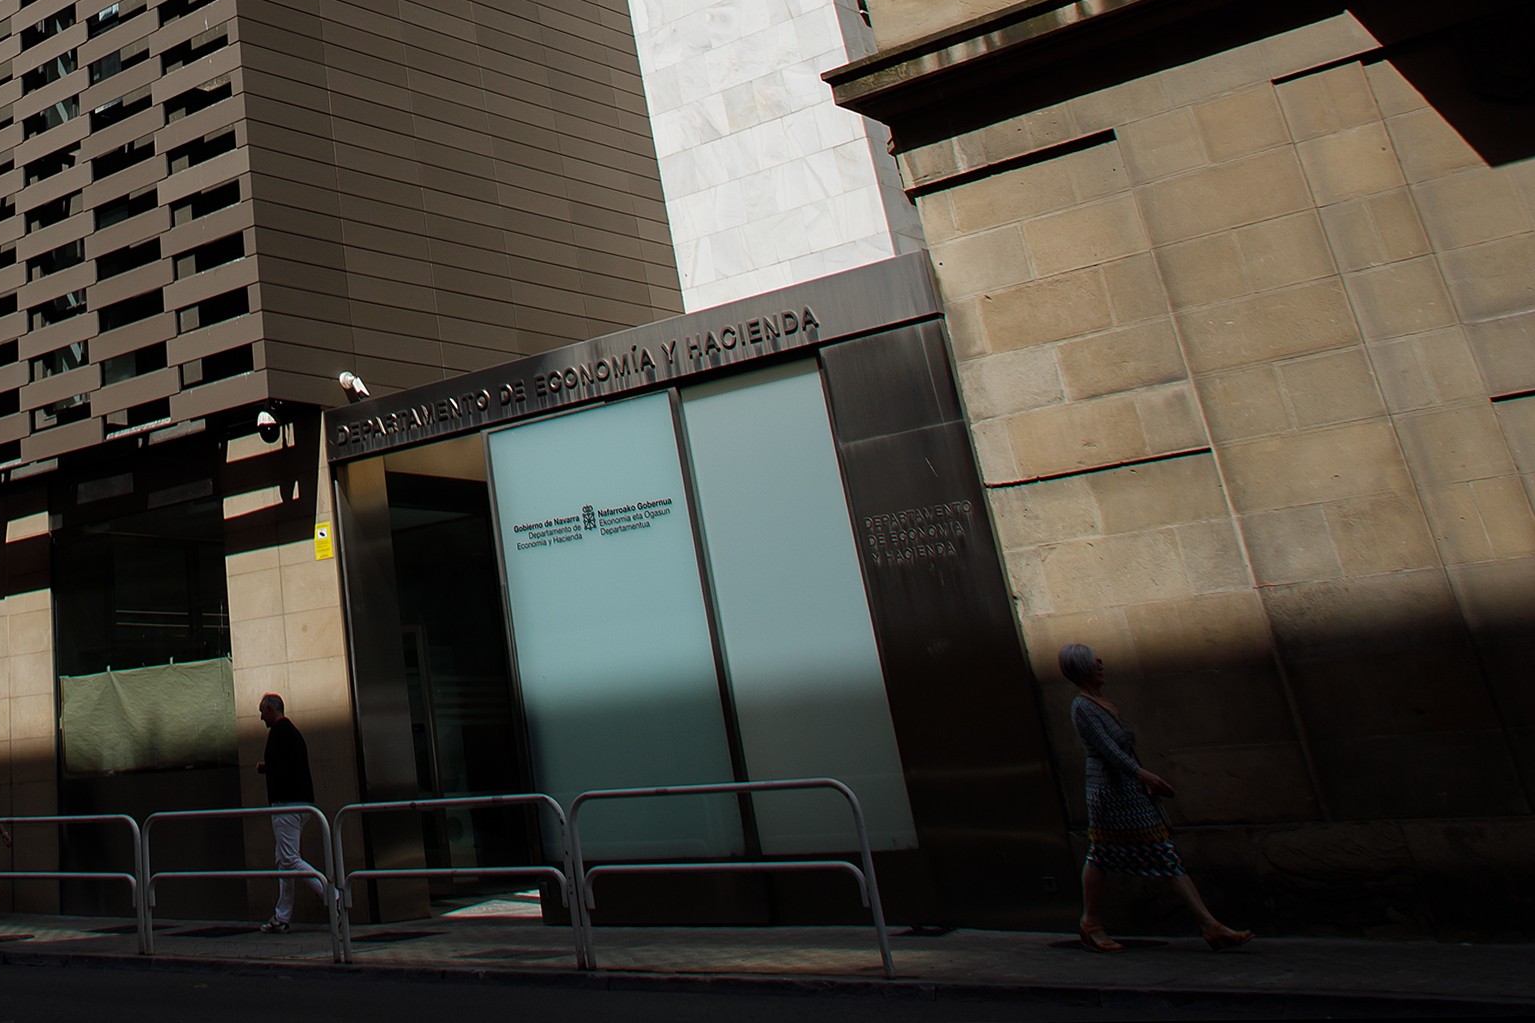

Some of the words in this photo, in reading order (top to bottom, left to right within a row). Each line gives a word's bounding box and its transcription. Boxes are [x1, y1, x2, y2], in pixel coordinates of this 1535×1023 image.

[337, 389, 491, 446] DEPARTAMENTO
[499, 379, 527, 406] DE
[535, 344, 656, 398] ECONOMÍA
[661, 339, 677, 365] Y
[686, 304, 821, 360] HACIENDA
[597, 504, 636, 518] Nafarroako
[637, 497, 672, 511] Gobernua
[599, 512, 631, 527] Ekonomia
[632, 510, 643, 521] eta
[644, 507, 671, 521] Ogasun
[864, 500, 972, 529] DEPARTAMENTO
[513, 521, 543, 533] Gobierno
[544, 518, 553, 527] de
[553, 515, 580, 526] Navarra
[528, 525, 572, 540] Departamento
[572, 523, 582, 532] de
[600, 520, 651, 536] Departamentua
[553, 532, 583, 545] Hacienda
[869, 534, 886, 547] DE
[872, 552, 880, 565] Y
[885, 541, 957, 563] HACIENDA
